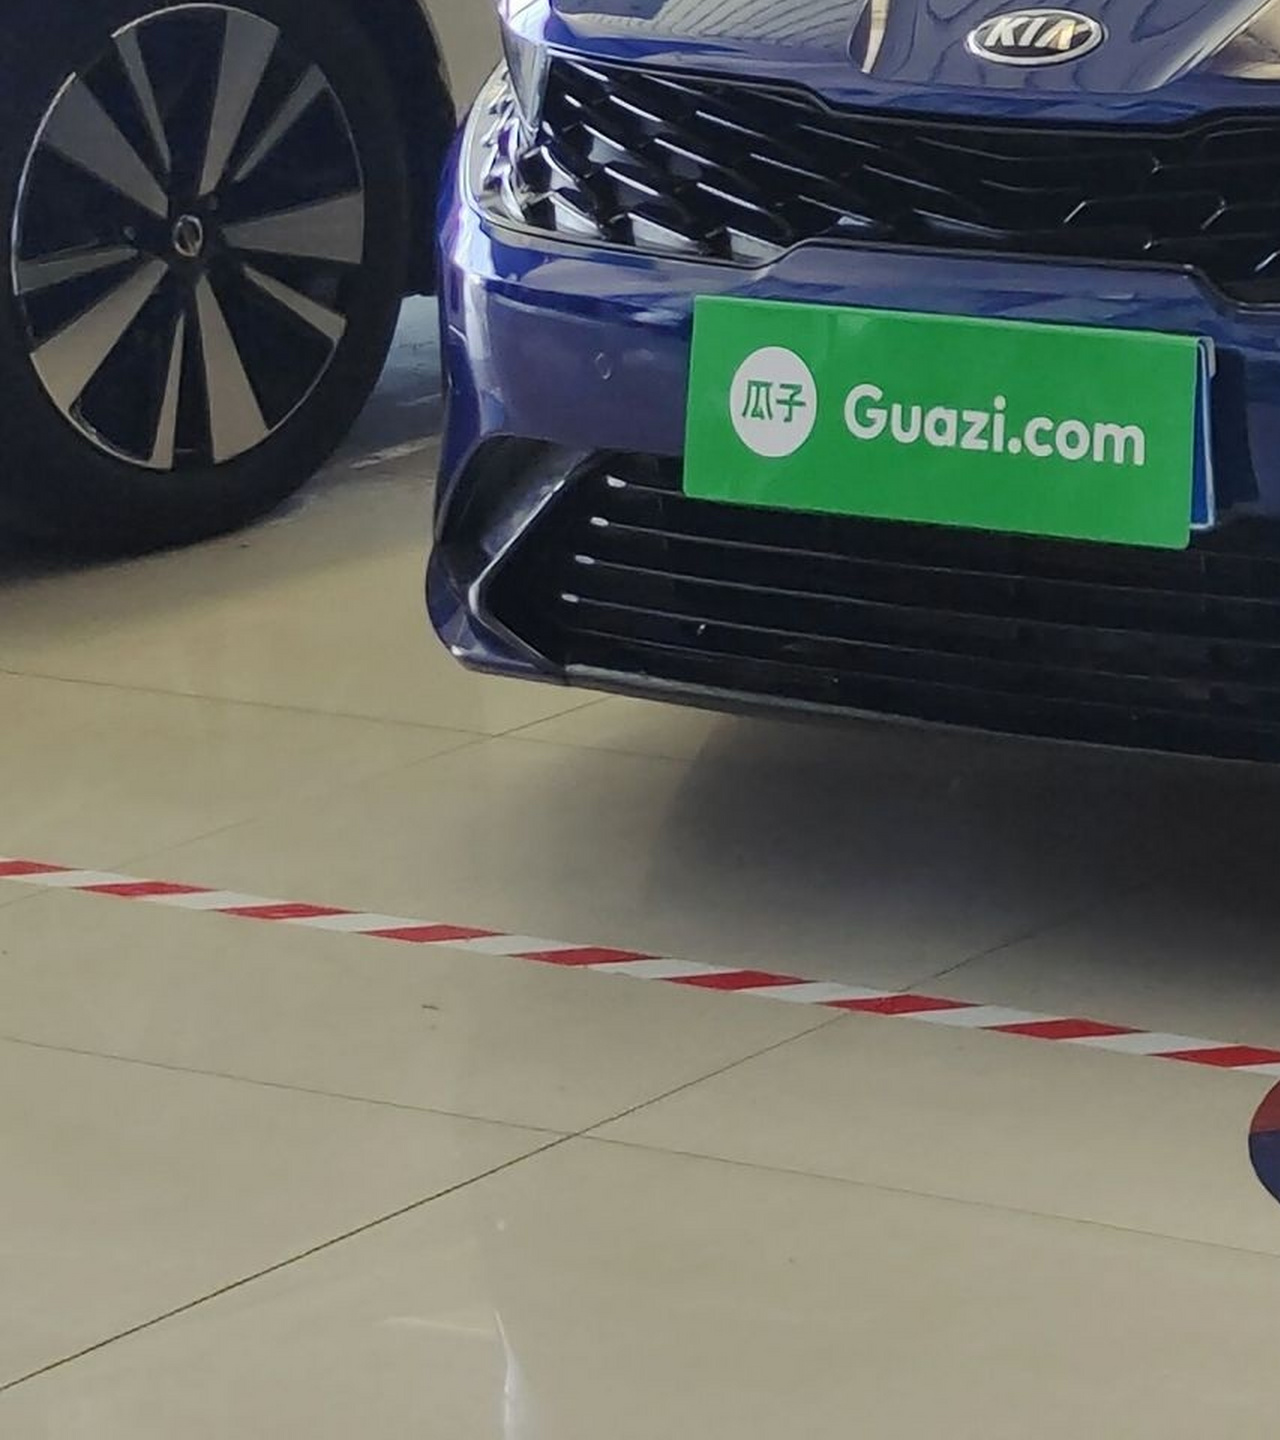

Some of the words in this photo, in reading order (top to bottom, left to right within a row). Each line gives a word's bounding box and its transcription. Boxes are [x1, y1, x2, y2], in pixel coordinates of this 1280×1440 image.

[983, 16, 1077, 51] KIA
[741, 379, 807, 423] 瓜子
[843, 383, 1147, 467] Guazi.com
